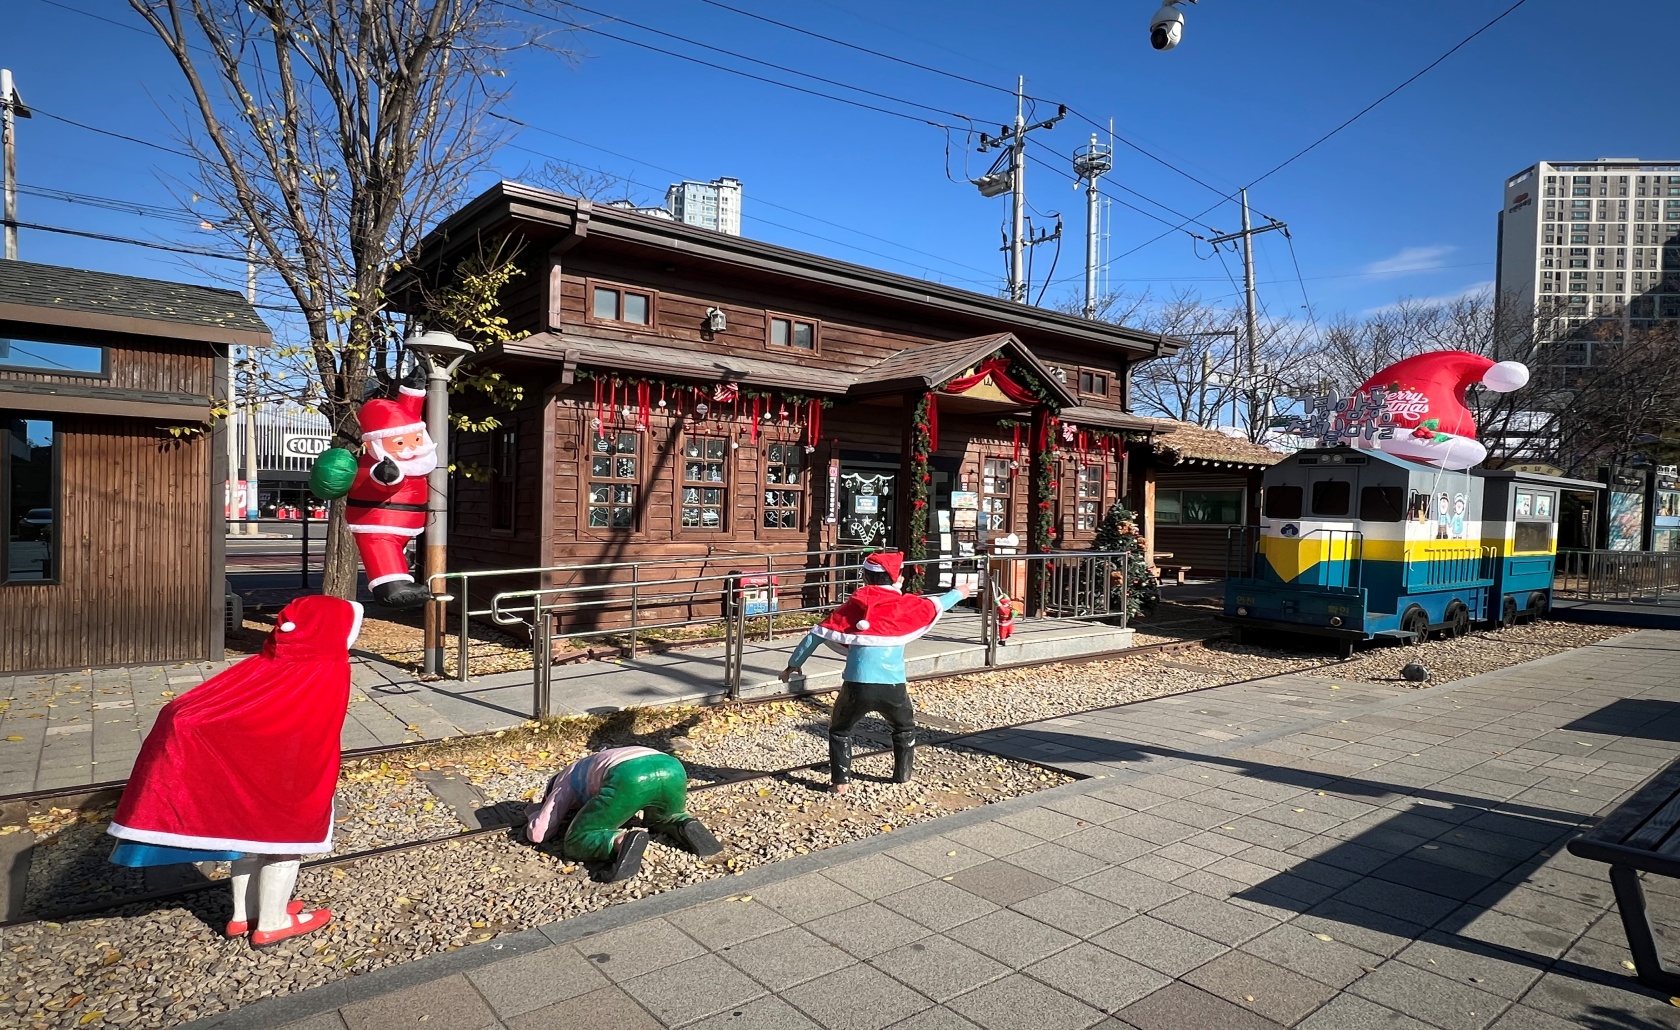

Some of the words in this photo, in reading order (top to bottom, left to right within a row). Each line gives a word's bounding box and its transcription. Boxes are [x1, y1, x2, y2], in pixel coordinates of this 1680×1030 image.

[1296, 385, 1388, 420] 경암동
[1385, 390, 1429, 403] erry
[1285, 414, 1401, 441] 철길마을
